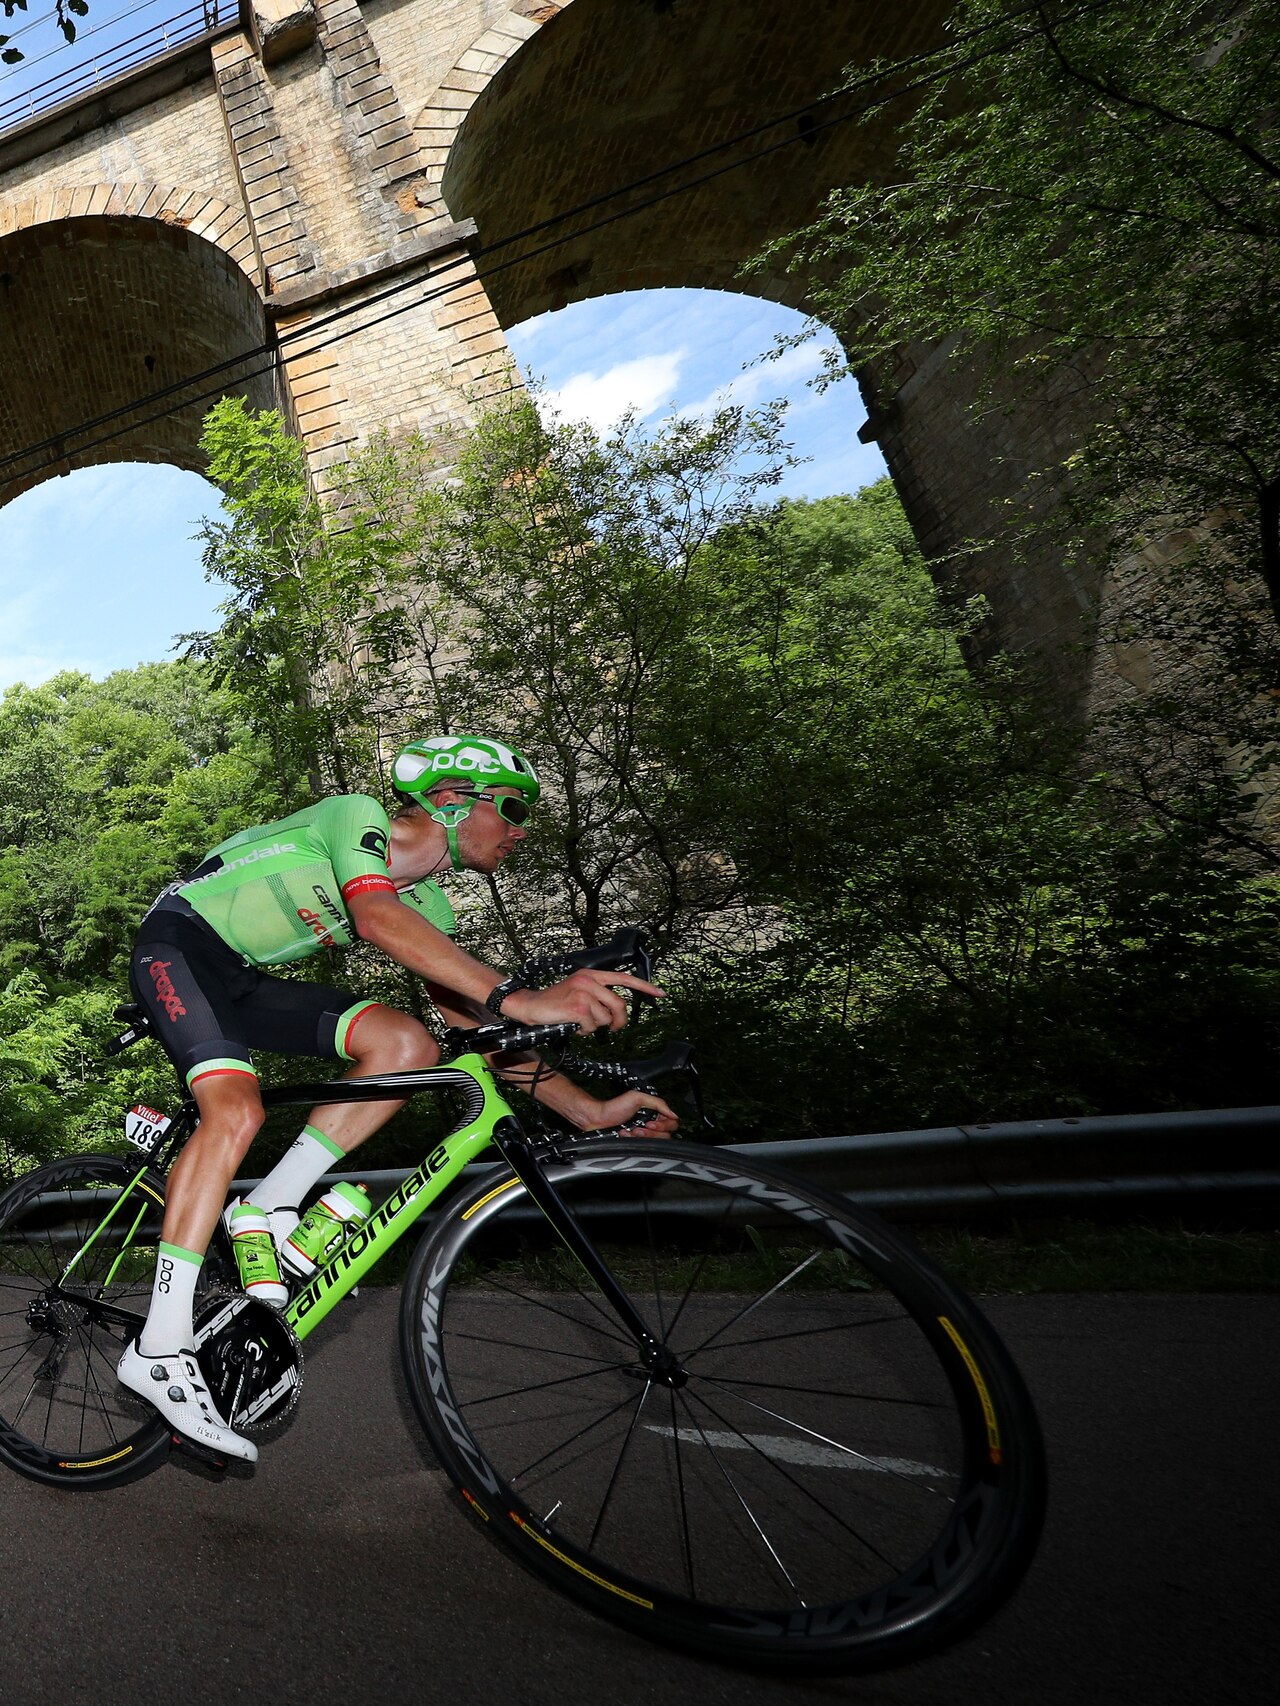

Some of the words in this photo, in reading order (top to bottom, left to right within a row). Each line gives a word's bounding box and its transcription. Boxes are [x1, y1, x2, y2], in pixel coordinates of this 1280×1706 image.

[149, 960, 187, 1022] drapac
[137, 1105, 160, 1123] Vittel
[129, 1121, 162, 1149] 189
